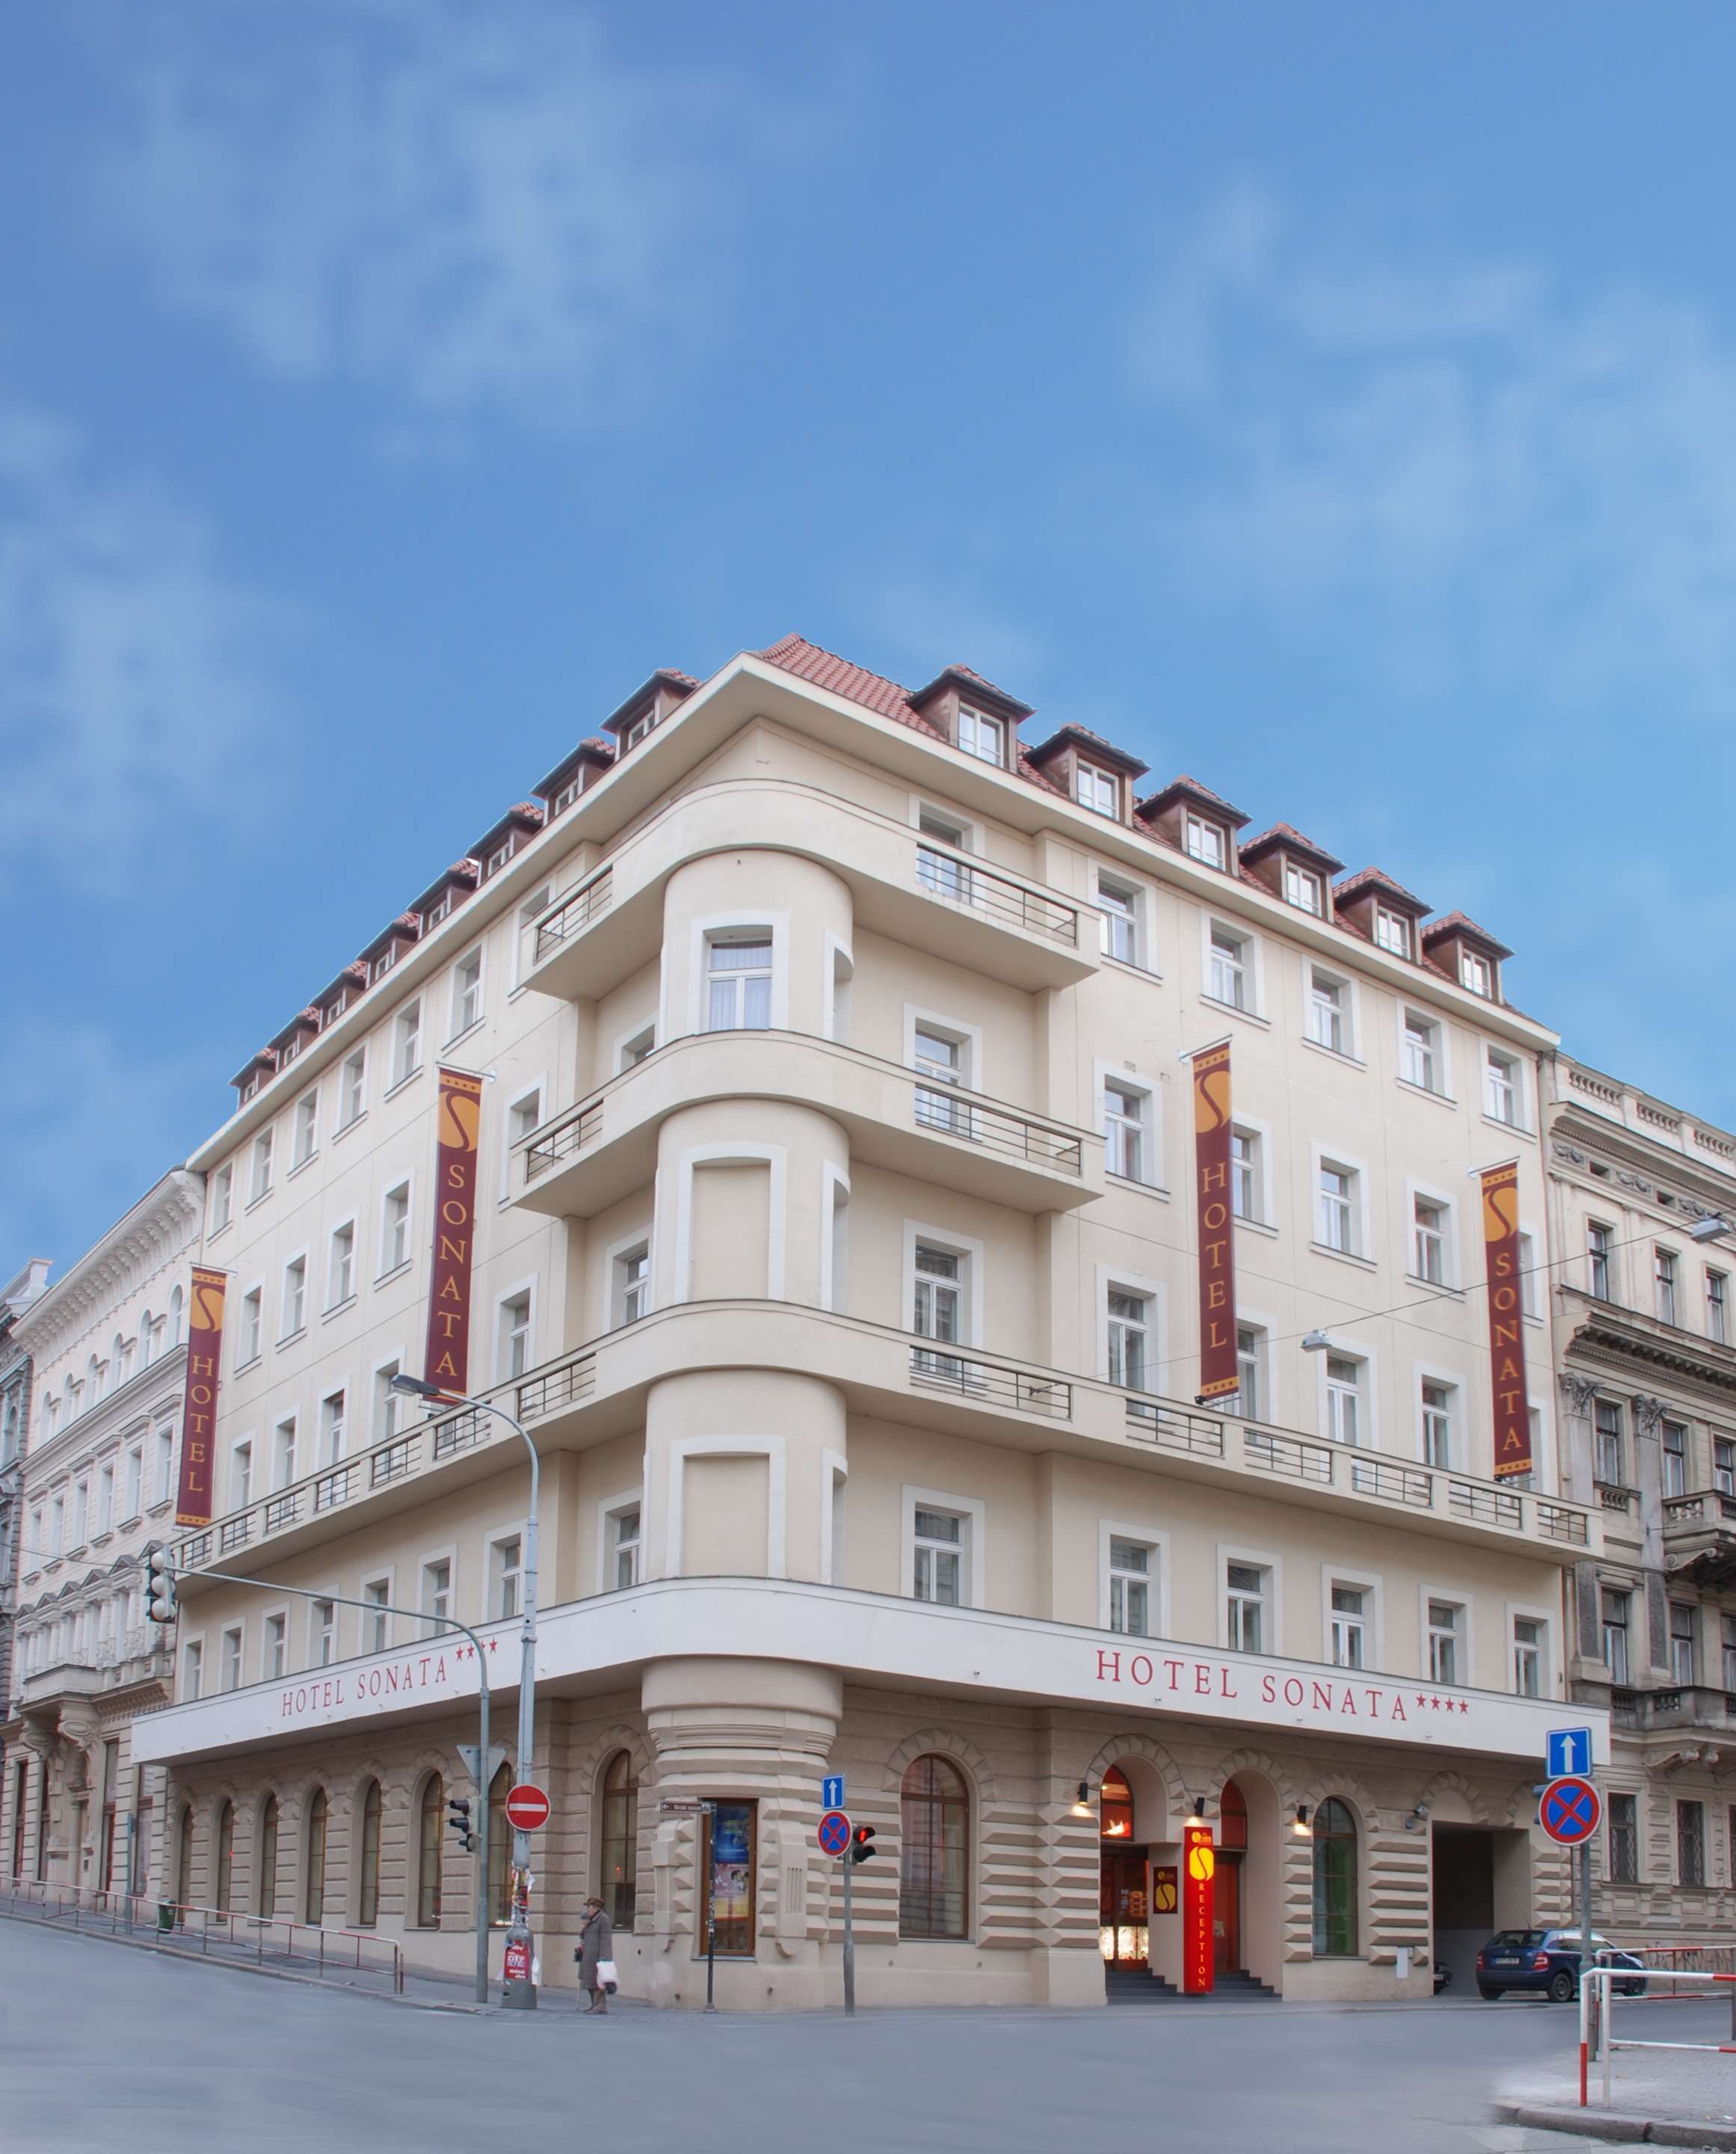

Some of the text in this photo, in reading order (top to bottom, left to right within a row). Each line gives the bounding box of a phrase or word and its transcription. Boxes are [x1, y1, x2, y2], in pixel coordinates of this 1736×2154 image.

[435, 1165, 467, 1376] SONATA
[1202, 1162, 1227, 1348] HOTEL
[188, 1355, 213, 1491] HOTEL
[1494, 1253, 1522, 1451] SONATA
[282, 1655, 446, 1716] HOTEL SONATA
[1096, 1651, 1406, 1721] HOTEL SONATA
